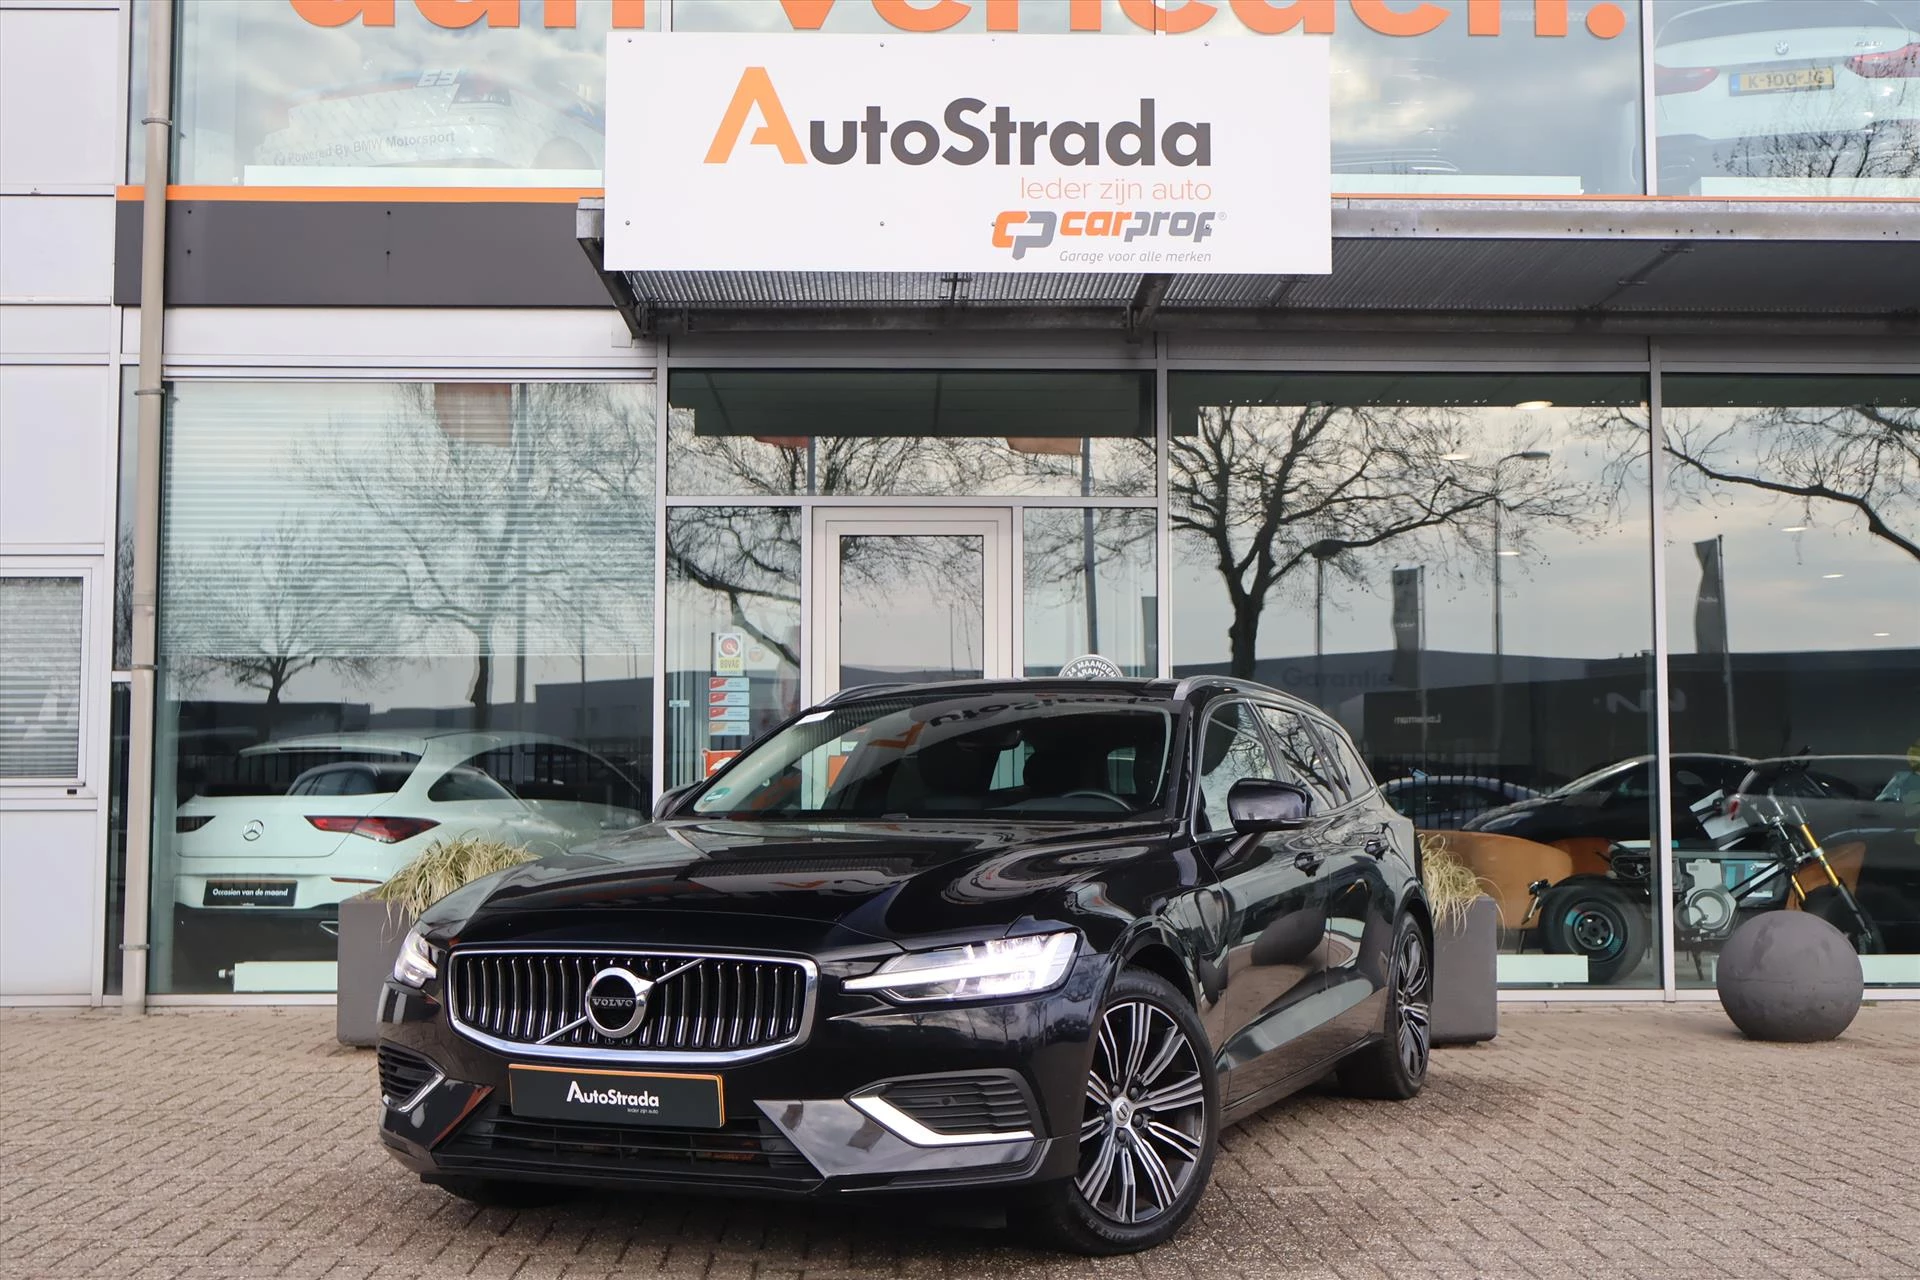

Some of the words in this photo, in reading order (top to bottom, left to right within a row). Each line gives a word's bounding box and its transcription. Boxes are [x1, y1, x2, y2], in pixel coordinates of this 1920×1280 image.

[703, 66, 1211, 166] AutoStrada
[288, 144, 332, 162] Powered
[335, 144, 351, 159] By
[354, 138, 385, 153] BMW
[386, 131, 456, 148] Motorsport
[1021, 177, 1091, 200] Ieder
[1100, 178, 1142, 206] zijn
[1152, 179, 1212, 201] auto
[1059, 211, 1216, 243] carprof
[1059, 250, 1104, 264] Garage
[1108, 252, 1137, 262] voor
[1139, 250, 1162, 262] alle
[1166, 251, 1212, 262] merken
[212, 888, 241, 896] Occasion
[255, 888, 263, 896] de
[264, 888, 288, 896] maand
[592, 999, 634, 1007] VOLVO
[566, 1081, 659, 1107] AutoStrada
